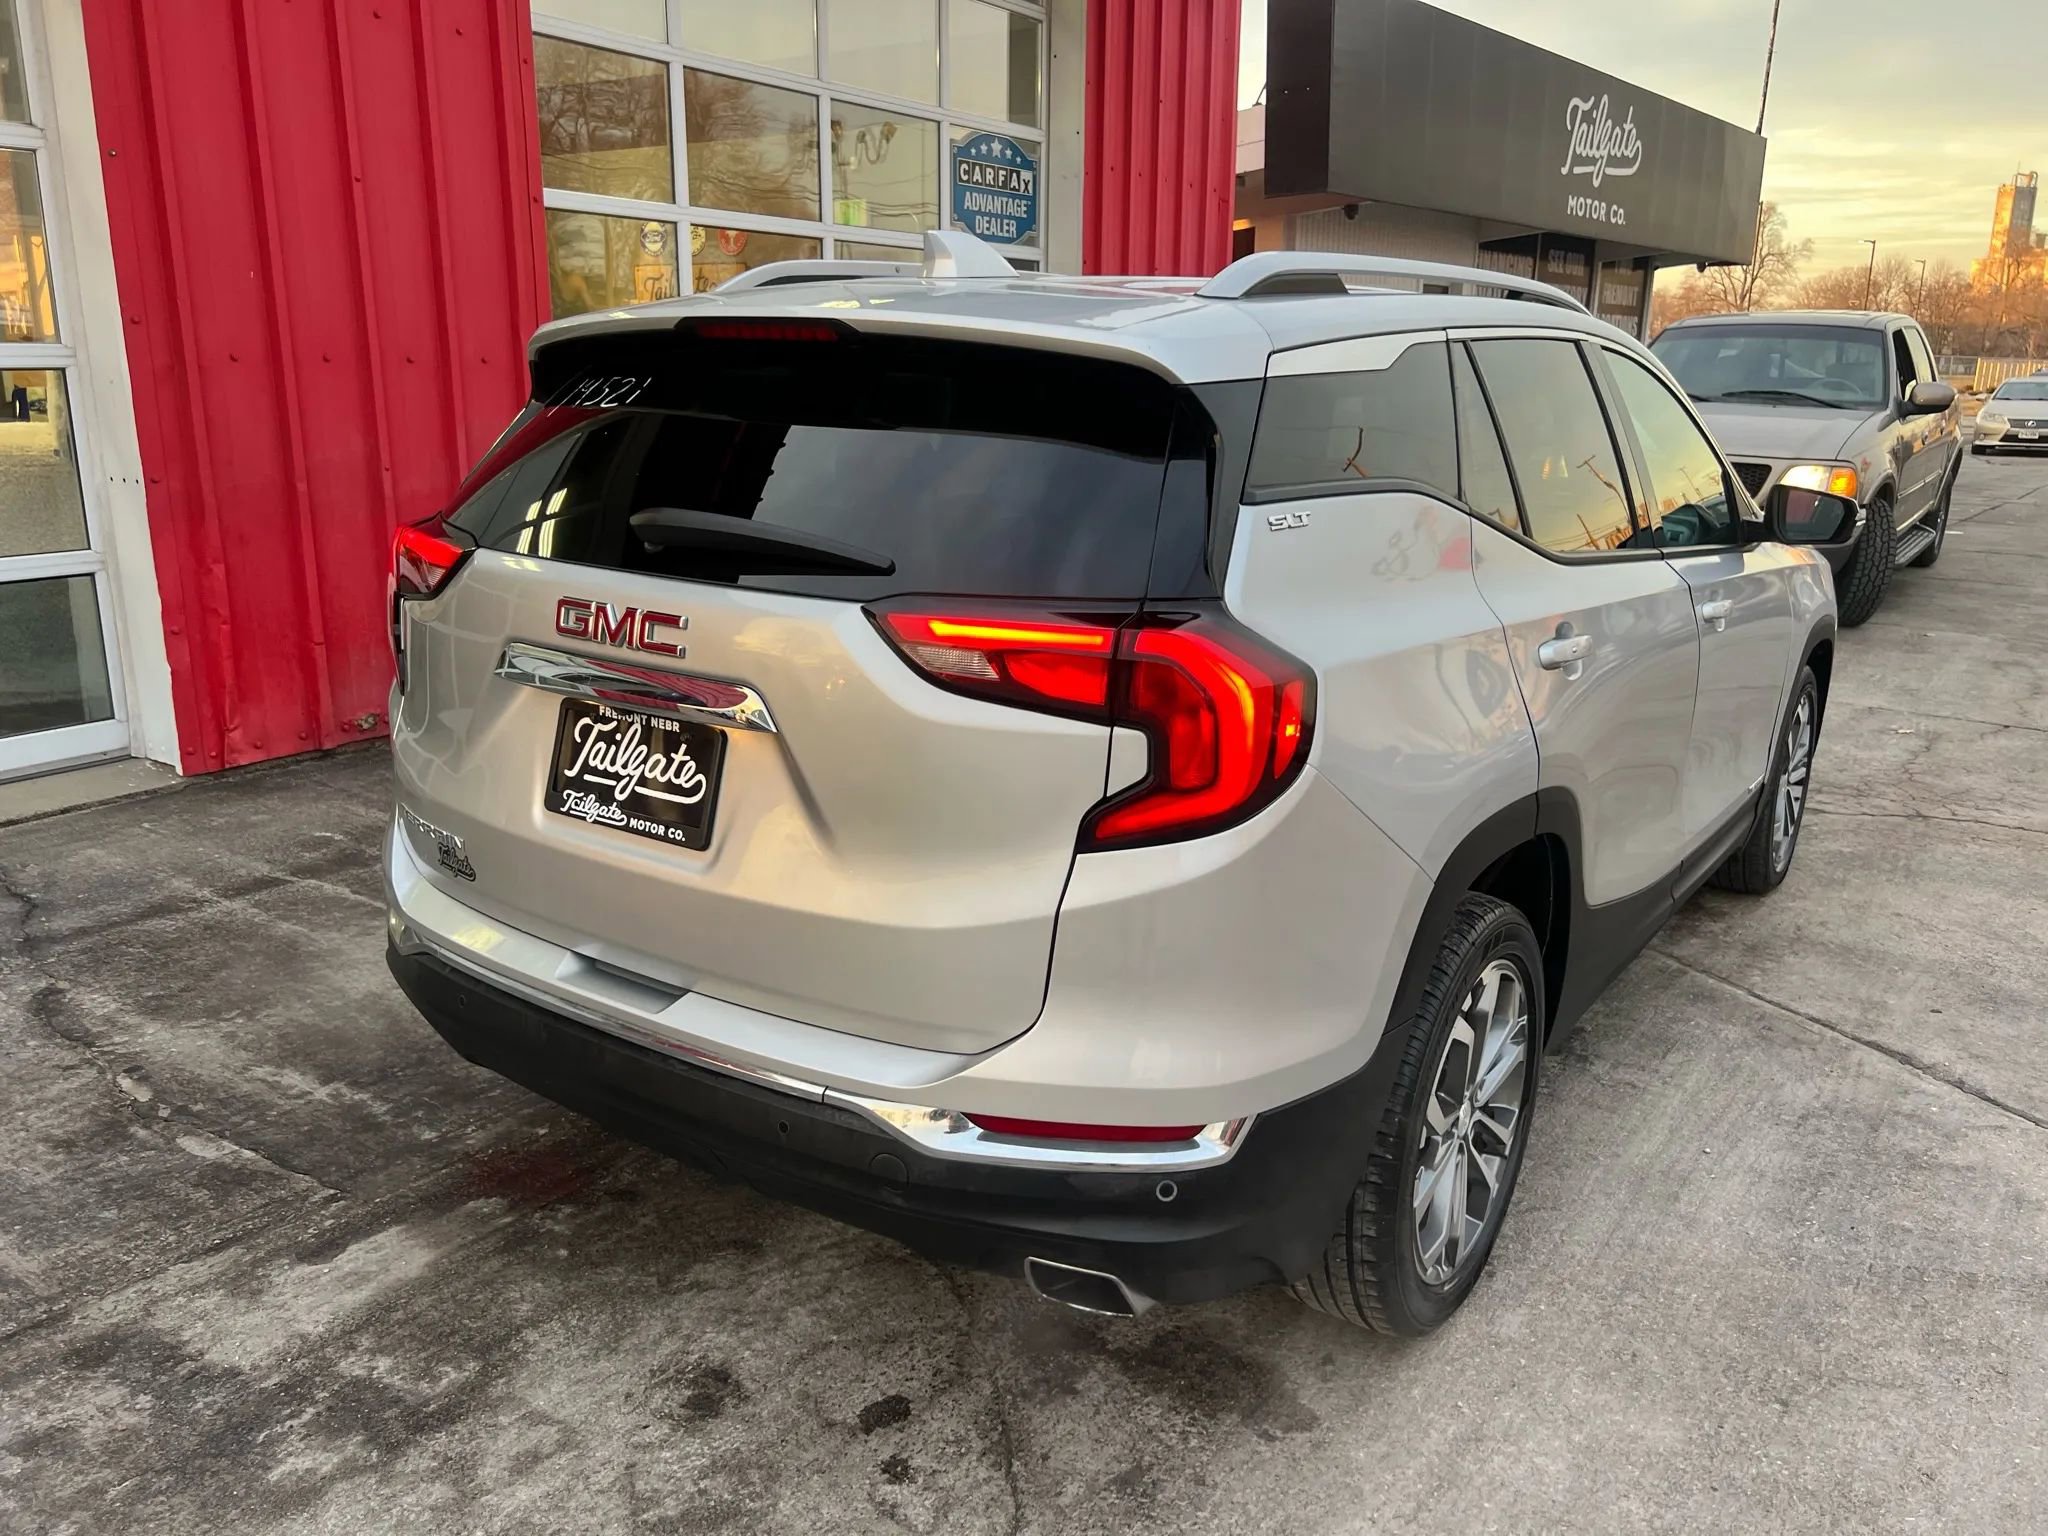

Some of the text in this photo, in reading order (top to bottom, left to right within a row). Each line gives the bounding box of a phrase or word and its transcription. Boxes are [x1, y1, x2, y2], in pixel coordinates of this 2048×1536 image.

[1561, 94, 1642, 188] Tailgate
[960, 163, 1031, 194] CARFAX
[1567, 195, 1626, 225] MOTOR CO.
[975, 215, 1017, 238] DEALER
[1267, 511, 1311, 532] SLT
[555, 595, 688, 659] GMC
[650, 716, 680, 733] NEBR
[563, 716, 707, 805] Tailgate
[560, 789, 686, 842] Tailgate MOTOR CO.
